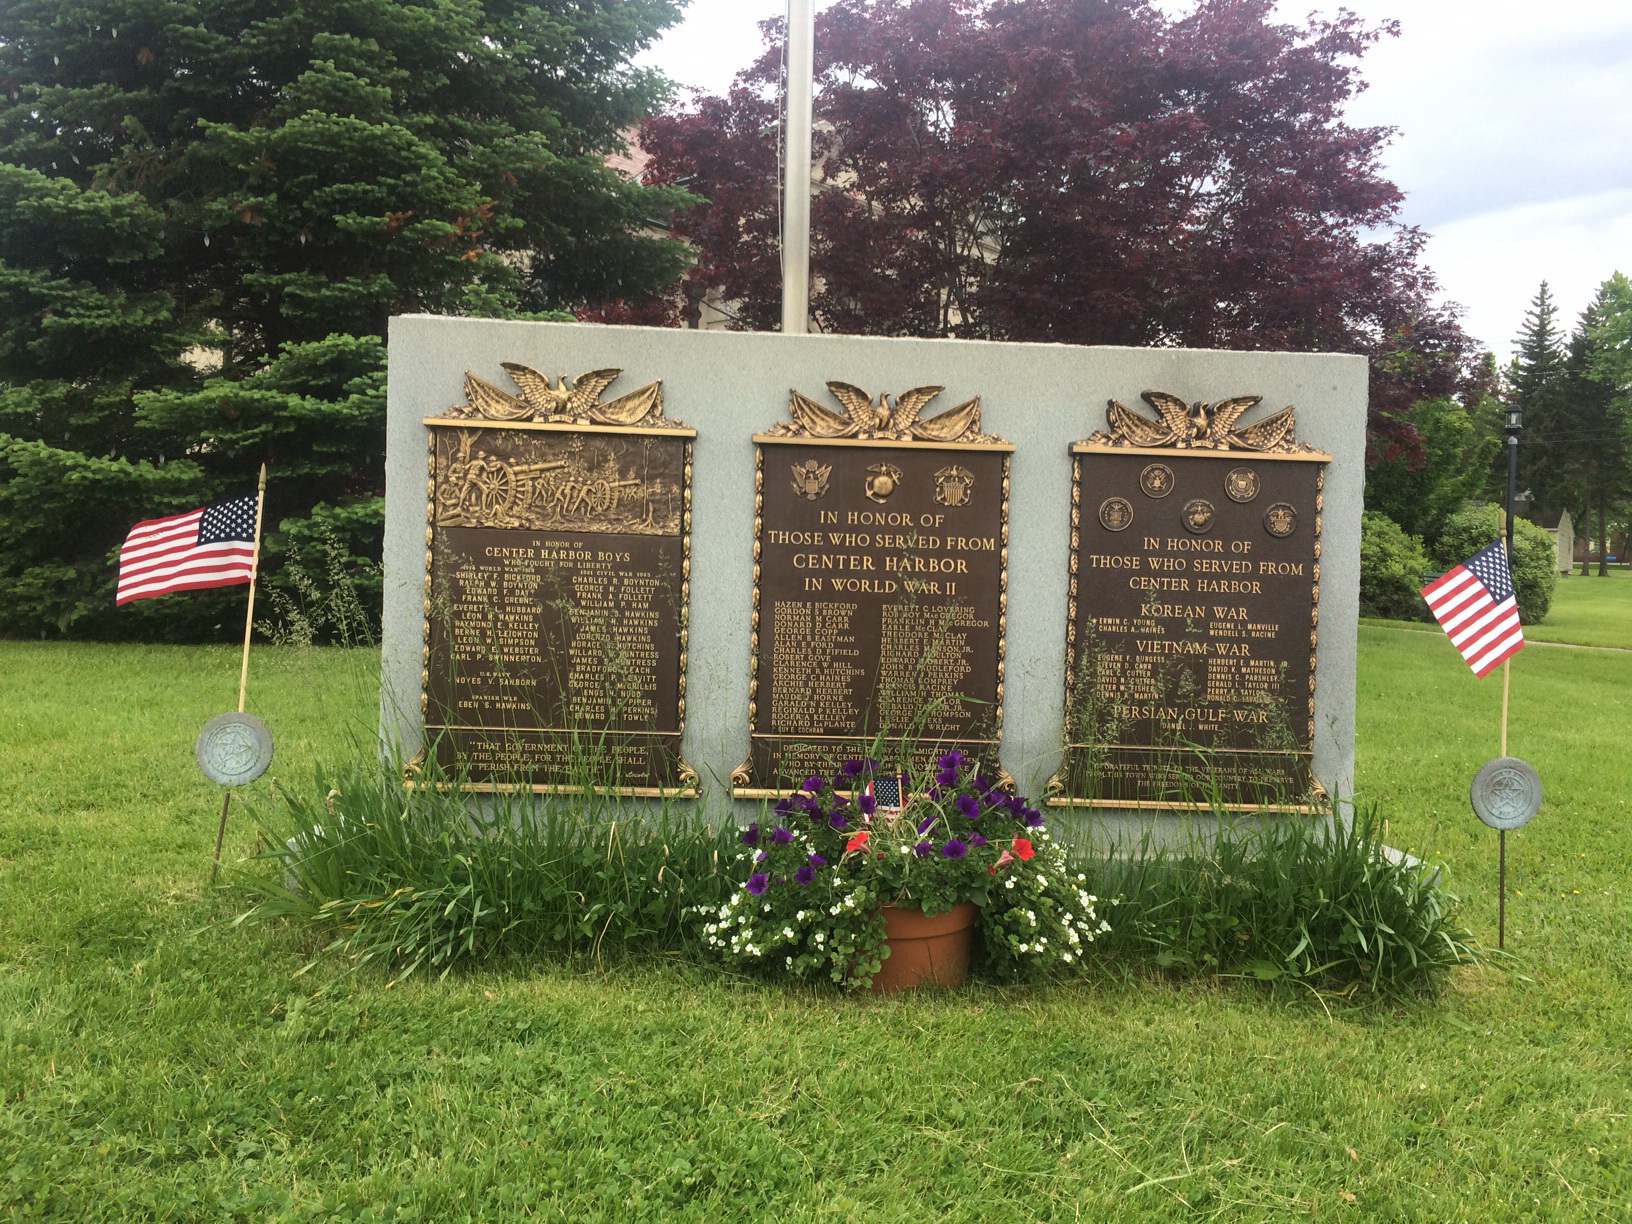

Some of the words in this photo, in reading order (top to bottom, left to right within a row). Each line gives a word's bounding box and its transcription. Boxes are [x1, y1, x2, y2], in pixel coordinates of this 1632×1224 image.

[820, 510, 839, 524] IN
[847, 511, 915, 527] HONOR
[920, 514, 945, 528] OF
[532, 540, 541, 548] IN
[545, 541, 570, 549] HONOR
[768, 530, 824, 546] THOSE
[828, 532, 871, 547] WHO
[875, 534, 941, 550] SERVED
[946, 536, 995, 551] FROM
[1143, 537, 1160, 550] IN
[1167, 538, 1224, 553] HONOR
[1231, 541, 1252, 554] OF
[485, 547, 535, 559] CENTER
[541, 549, 592, 561] HARBOR
[598, 551, 631, 562] BOYS
[503, 559, 521, 567] WHO
[525, 560, 556, 568] FOUGHT
[560, 561, 574, 569] FOR
[577, 562, 613, 570] LIBERTY
[793, 553, 877, 571] CENTER
[885, 556, 969, 574] HARBOR
[1090, 555, 1141, 570] THOSE
[1148, 557, 1186, 571] WHO
[1193, 559, 1252, 574] SERVED
[1259, 562, 1304, 576] FROM
[455, 572, 489, 580] SHIRLEY
[504, 574, 541, 582] BICKFORD
[572, 576, 608, 585] CHARLES
[612, 578, 620, 586] R.
[624, 578, 660, 587] BOYNTON
[575, 584, 604, 593] GEORGE
[621, 586, 656, 595] FOLLETT
[804, 577, 823, 591] IN
[830, 578, 897, 593] WORLD
[903, 580, 943, 595] WAR
[945, 582, 957, 595] II
[1129, 576, 1190, 591] CENTER
[1197, 579, 1262, 594] HARBOR
[577, 592, 602, 600] FRANK
[608, 593, 616, 601] A.
[619, 593, 653, 602] FOLLETT
[580, 600, 615, 608] WILLIAM
[621, 601, 627, 609] P.
[632, 602, 649, 610] HAM
[774, 601, 803, 609] HAZEN
[815, 602, 858, 610] BICKFORD
[774, 607, 811, 615] GORDON
[822, 609, 853, 617] BROWN
[1140, 603, 1206, 619] KOREAN
[1213, 606, 1249, 620] WAR
[461, 612, 482, 620] LEON
[499, 614, 534, 622] HAWKINS
[774, 614, 811, 622] NORMAN
[1099, 617, 1121, 626] ERWIN
[1133, 619, 1155, 627] YOUNG
[455, 620, 492, 628] RAYMOND
[509, 622, 540, 631] KELLEY
[580, 625, 607, 633] JAMES
[612, 626, 648, 635] HAWKINS
[774, 621, 812, 629] DONARD
[825, 622, 850, 630] CARR
[1098, 625, 1128, 633] CHARLES
[1210, 622, 1235, 630] EUGENE
[1247, 623, 1279, 632] MANVILLE
[774, 634, 803, 642] ALLEN
[815, 635, 855, 643] EASTMAN
[1209, 629, 1239, 637] WENDELL
[1251, 631, 1276, 639] RACINE
[457, 636, 480, 644] LEON
[499, 638, 535, 646] SIMPSON
[811, 641, 834, 649] FORD
[454, 645, 486, 653] EDWARD
[503, 646, 539, 655] WEBSTER
[826, 649, 860, 657] FIFIELD
[1135, 640, 1208, 655] VIETNAM
[1215, 643, 1251, 657] WAR
[450, 653, 471, 661] CARL
[488, 654, 542, 663] SWINNERTON
[773, 653, 805, 661] ROBERT
[808, 654, 831, 662] GOVE
[1097, 653, 1123, 662] EUGENE
[1136, 655, 1165, 663] BURGESS
[1208, 658, 1237, 666] HERBERT
[773, 660, 818, 668] CLARENCE
[773, 667, 812, 675] KENNETH
[824, 668, 866, 677] HUTCHINS
[1208, 665, 1228, 673] DAVID
[1241, 667, 1276, 675] MATHESON
[773, 673, 807, 681] GEORGE
[820, 675, 851, 683] HAINES
[1207, 673, 1232, 681] DENNIS
[1245, 674, 1278, 682] PARSHLEY
[773, 679, 805, 687] ARCHIE
[808, 681, 846, 689] HERBERT
[1207, 680, 1232, 688] GERALD
[1245, 681, 1269, 690] TAYLOR
[458, 701, 479, 709] EBEN
[495, 702, 531, 711] HAWKINS
[772, 713, 801, 721] ROGER
[813, 714, 847, 722] KELLEY
[1113, 705, 1179, 720] PERSIAN
[1185, 708, 1226, 722] GULF
[1233, 709, 1269, 723] WAR
[771, 719, 811, 728] RICHARD
[1198, 723, 1219, 731] WHITE
[505, 743, 569, 752] GOVERNMENT
[616, 756, 646, 765] SHALL
